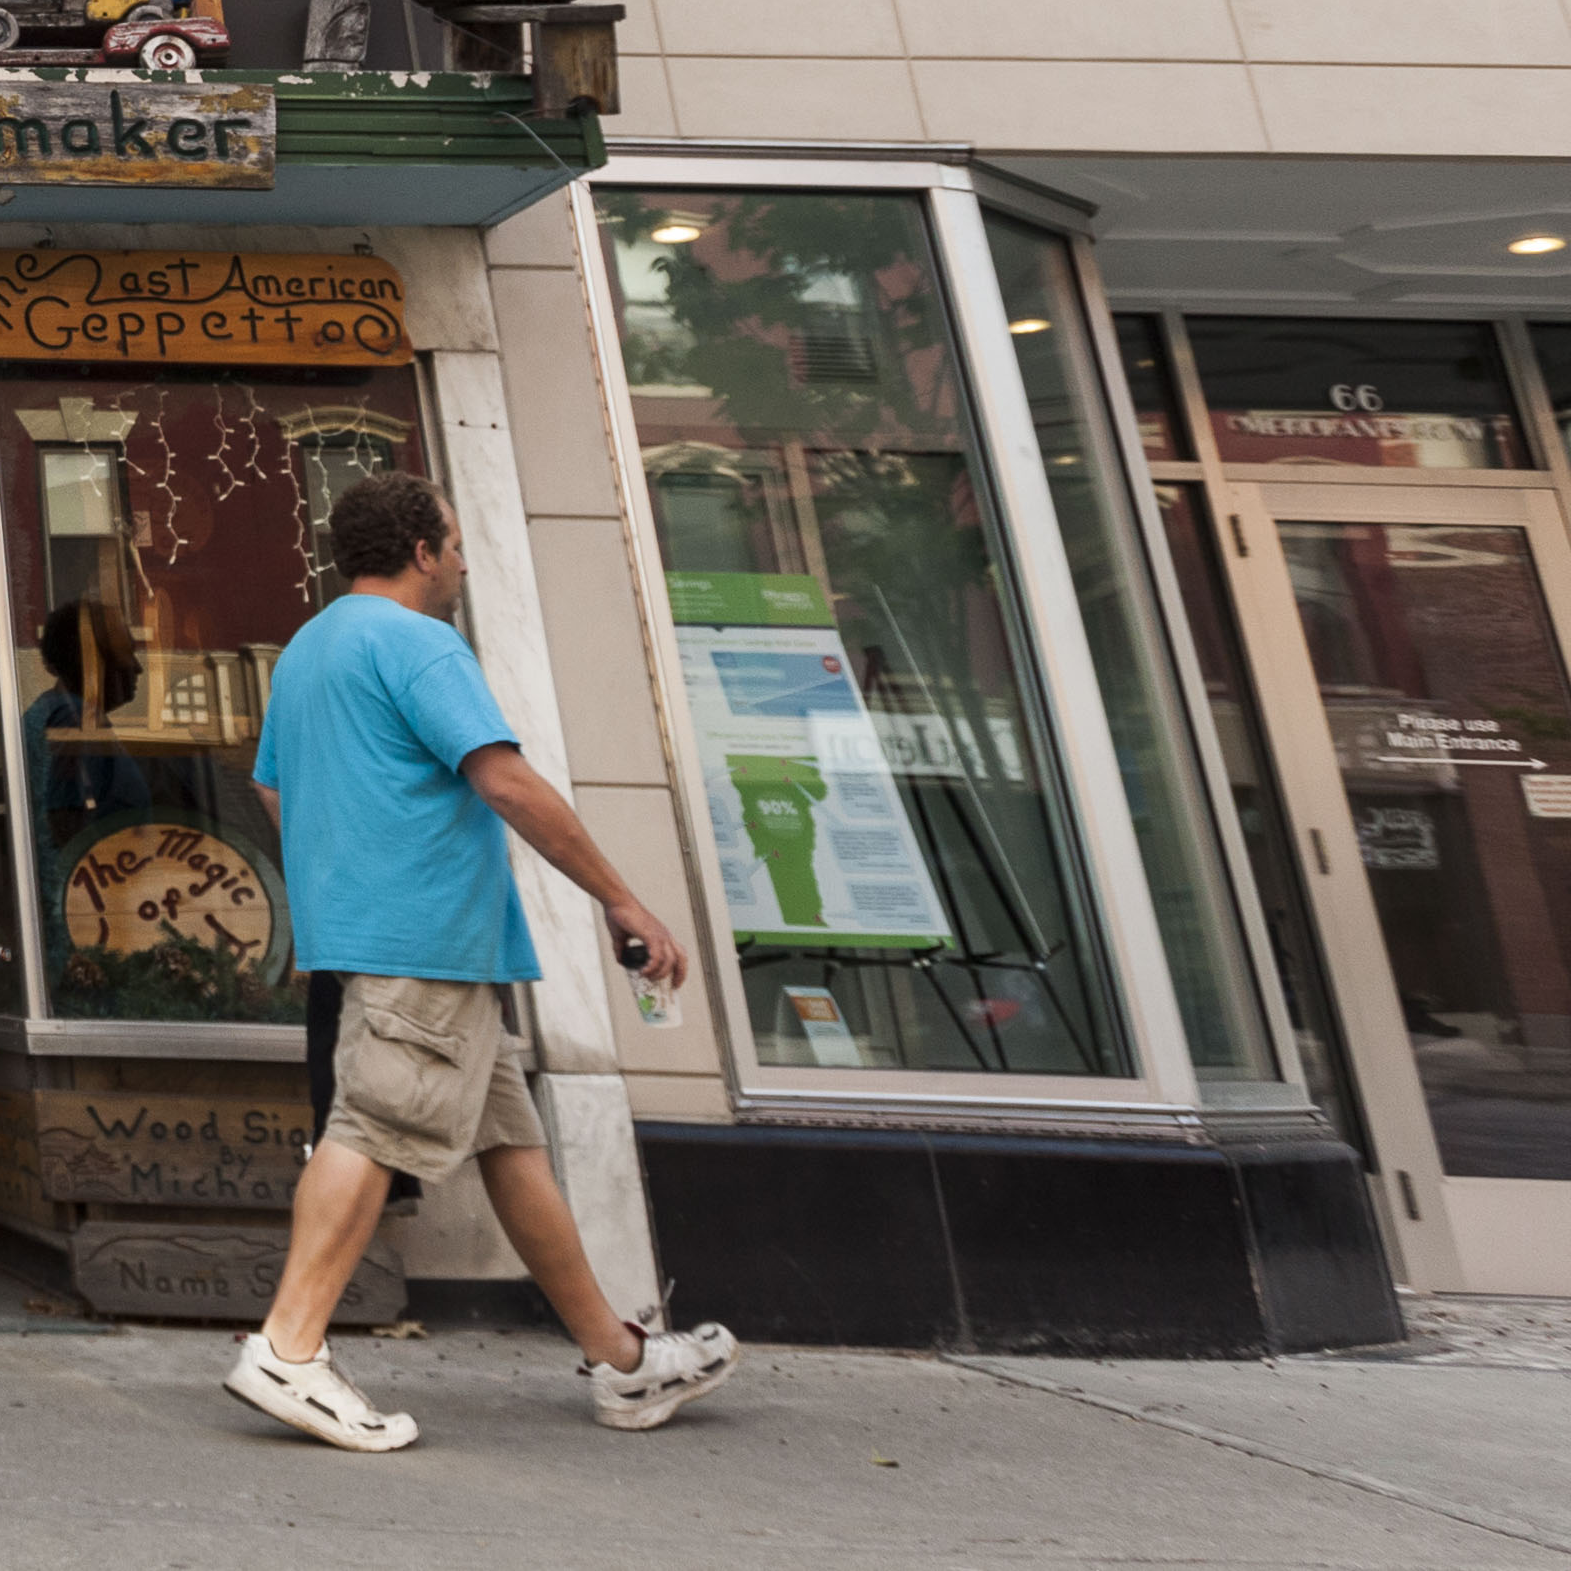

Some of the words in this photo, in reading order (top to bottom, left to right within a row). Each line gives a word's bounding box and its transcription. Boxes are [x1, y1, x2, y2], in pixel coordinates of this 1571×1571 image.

[67, 253, 201, 306] Last
[209, 254, 404, 306] American
[1329, 383, 1385, 413] 66
[1435, 732, 1523, 753] Entrance
[1463, 718, 1501, 733] use
[70, 844, 156, 913] The
[155, 827, 257, 907] Magic
[136, 886, 182, 922] of
[85, 1104, 222, 1143] Wood
[129, 1162, 297, 1202] Micha
[117, 1258, 231, 1299] Name
